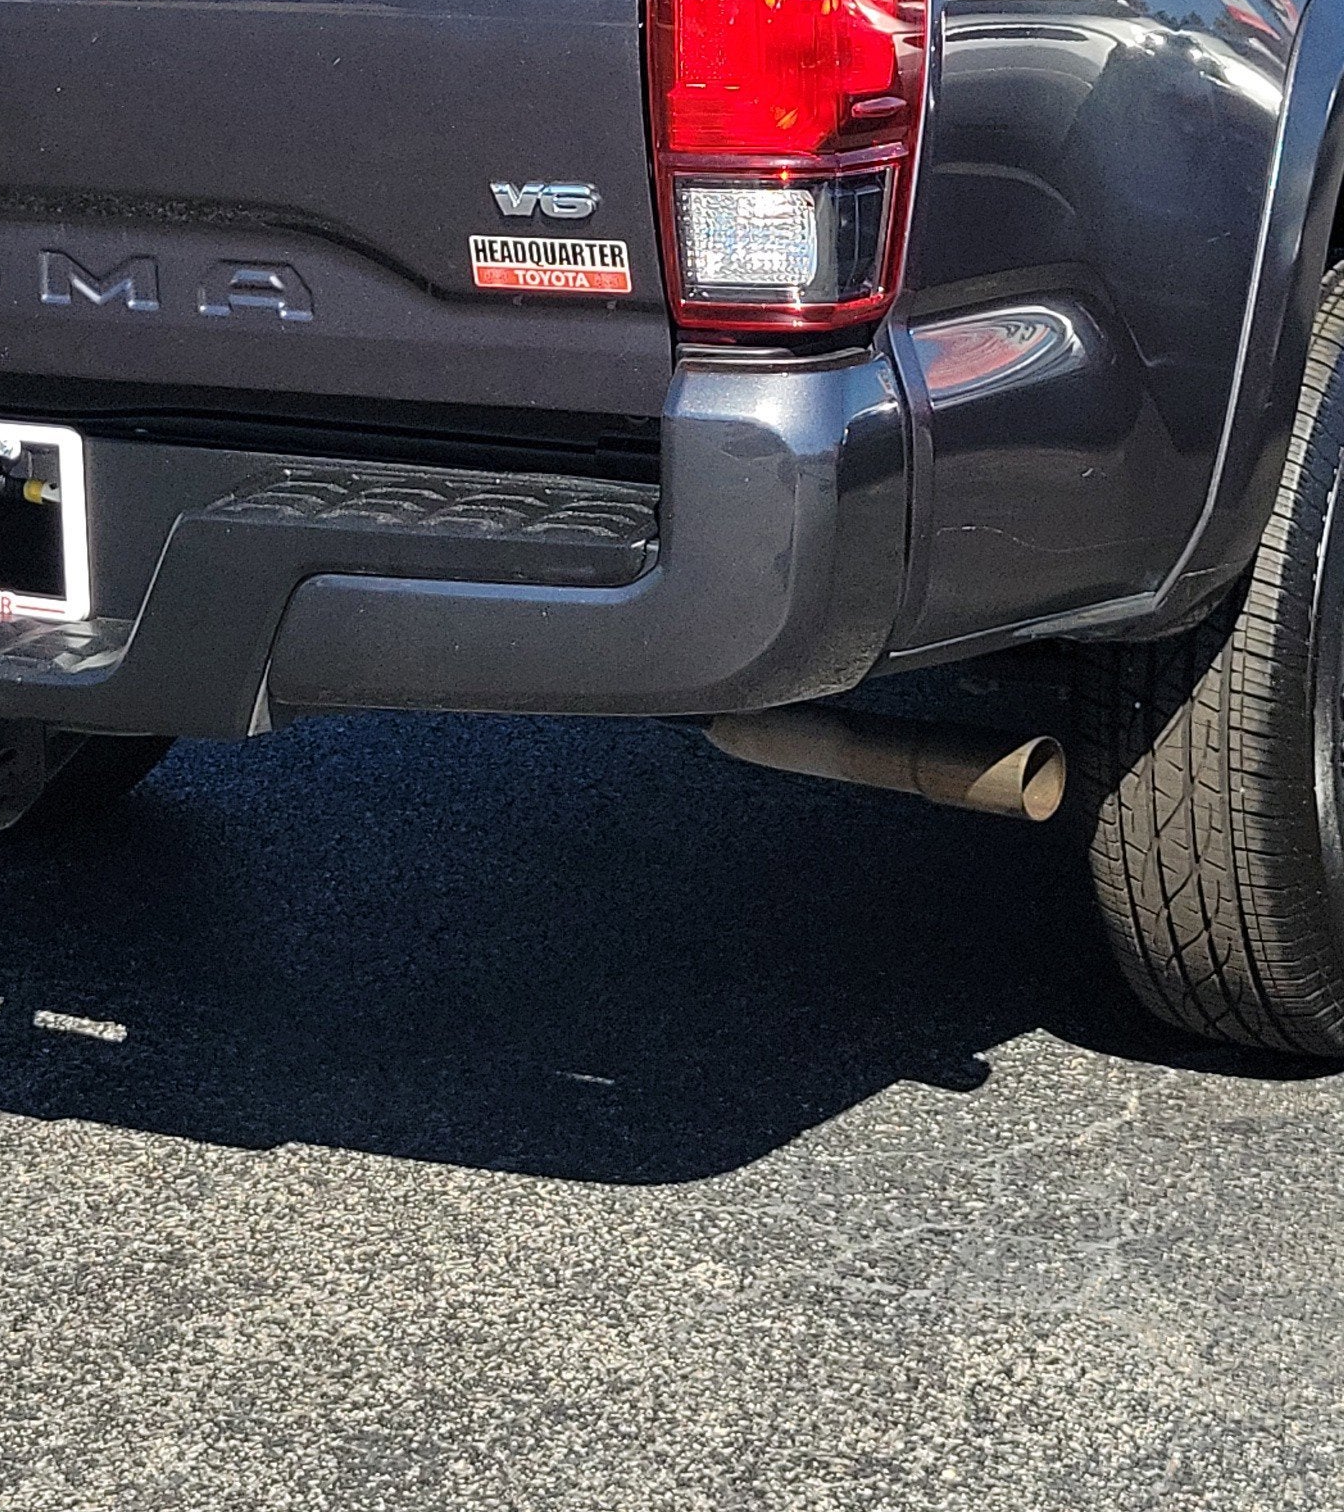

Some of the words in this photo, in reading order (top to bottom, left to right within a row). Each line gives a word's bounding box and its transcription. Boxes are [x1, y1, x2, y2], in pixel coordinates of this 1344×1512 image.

[490, 179, 602, 221] V6
[472, 238, 626, 268] HEADQUARTER
[513, 268, 591, 289] TOYOTA
